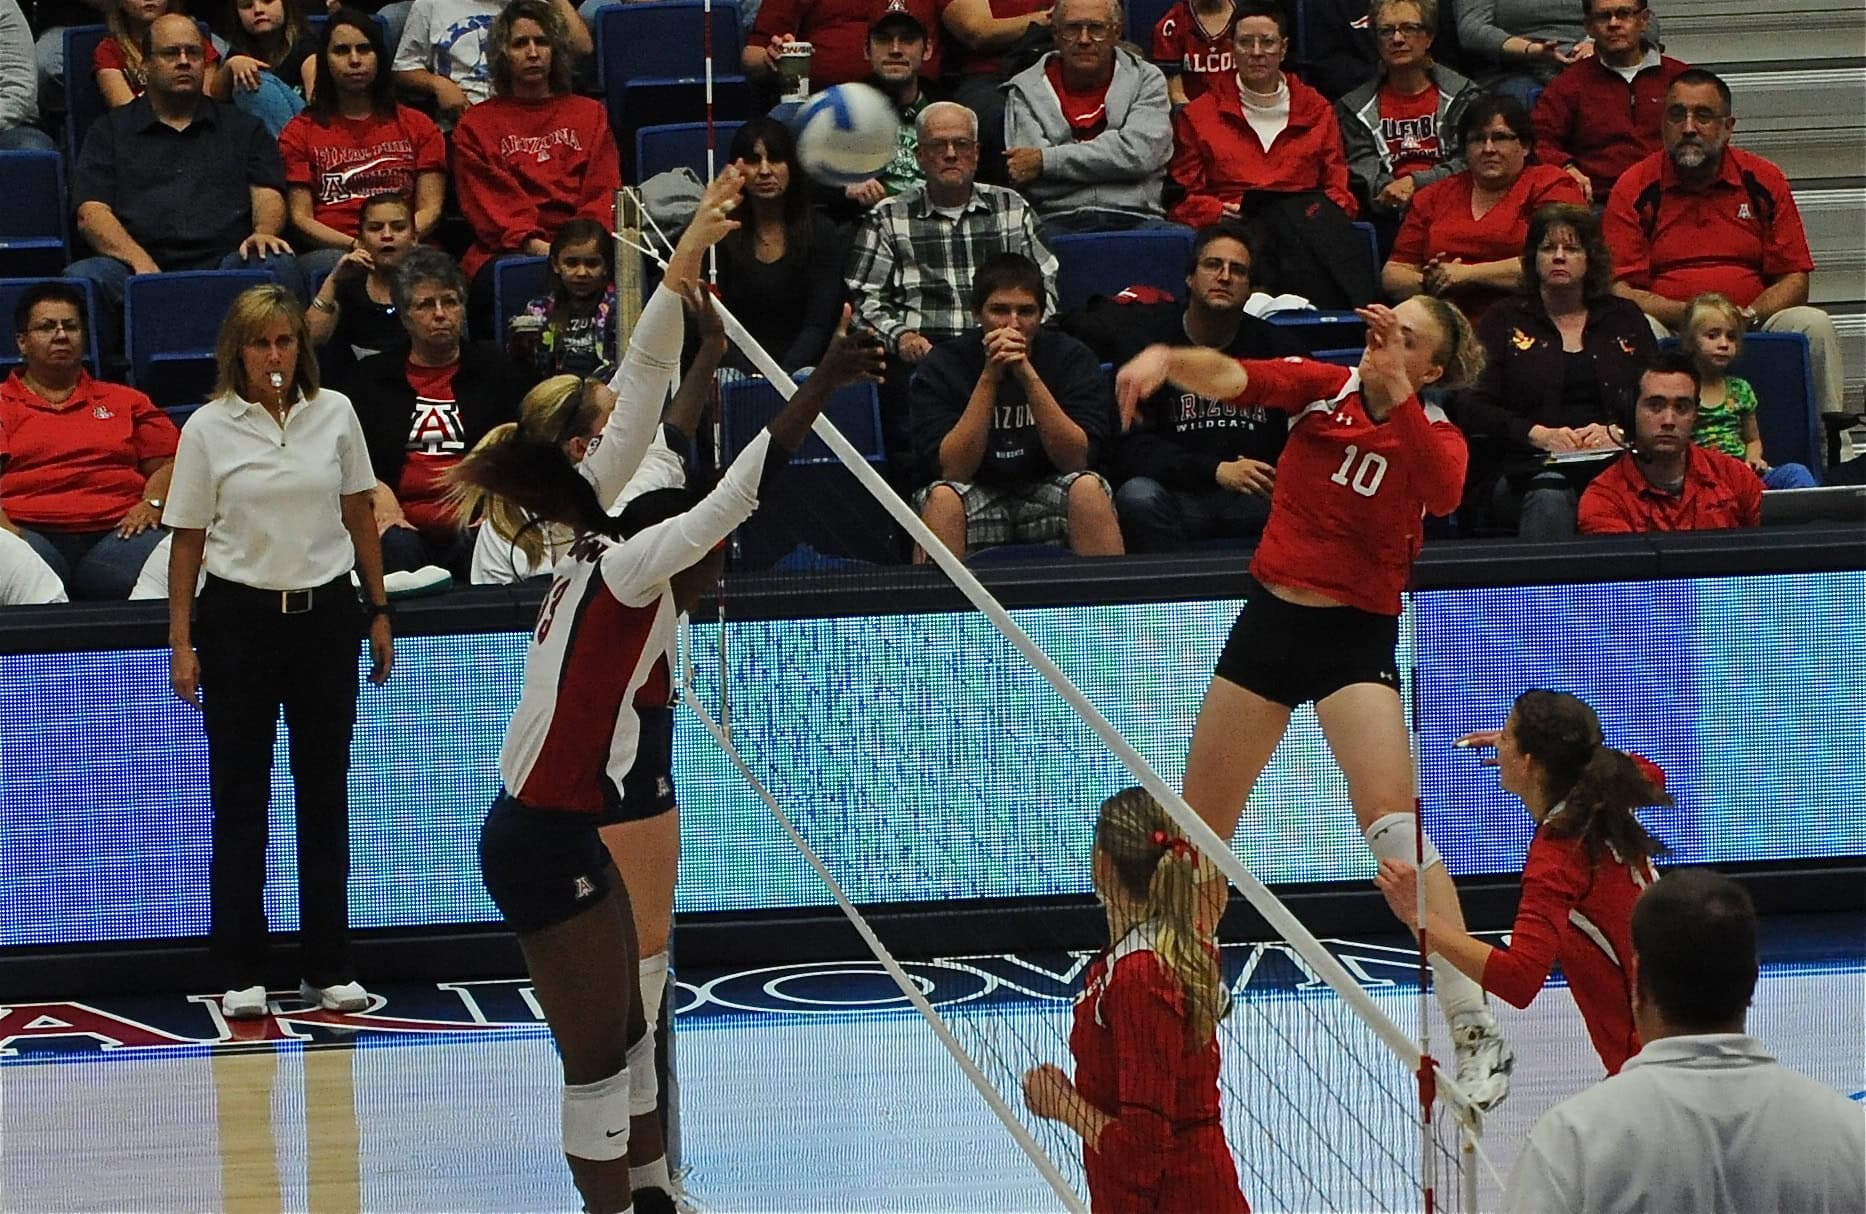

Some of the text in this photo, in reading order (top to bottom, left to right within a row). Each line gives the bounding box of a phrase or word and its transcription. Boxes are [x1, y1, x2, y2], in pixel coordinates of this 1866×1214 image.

[1183, 51, 1238, 73] ALCO
[406, 396, 465, 456] A
[1331, 444, 1388, 497] 10
[575, 876, 595, 898] A
